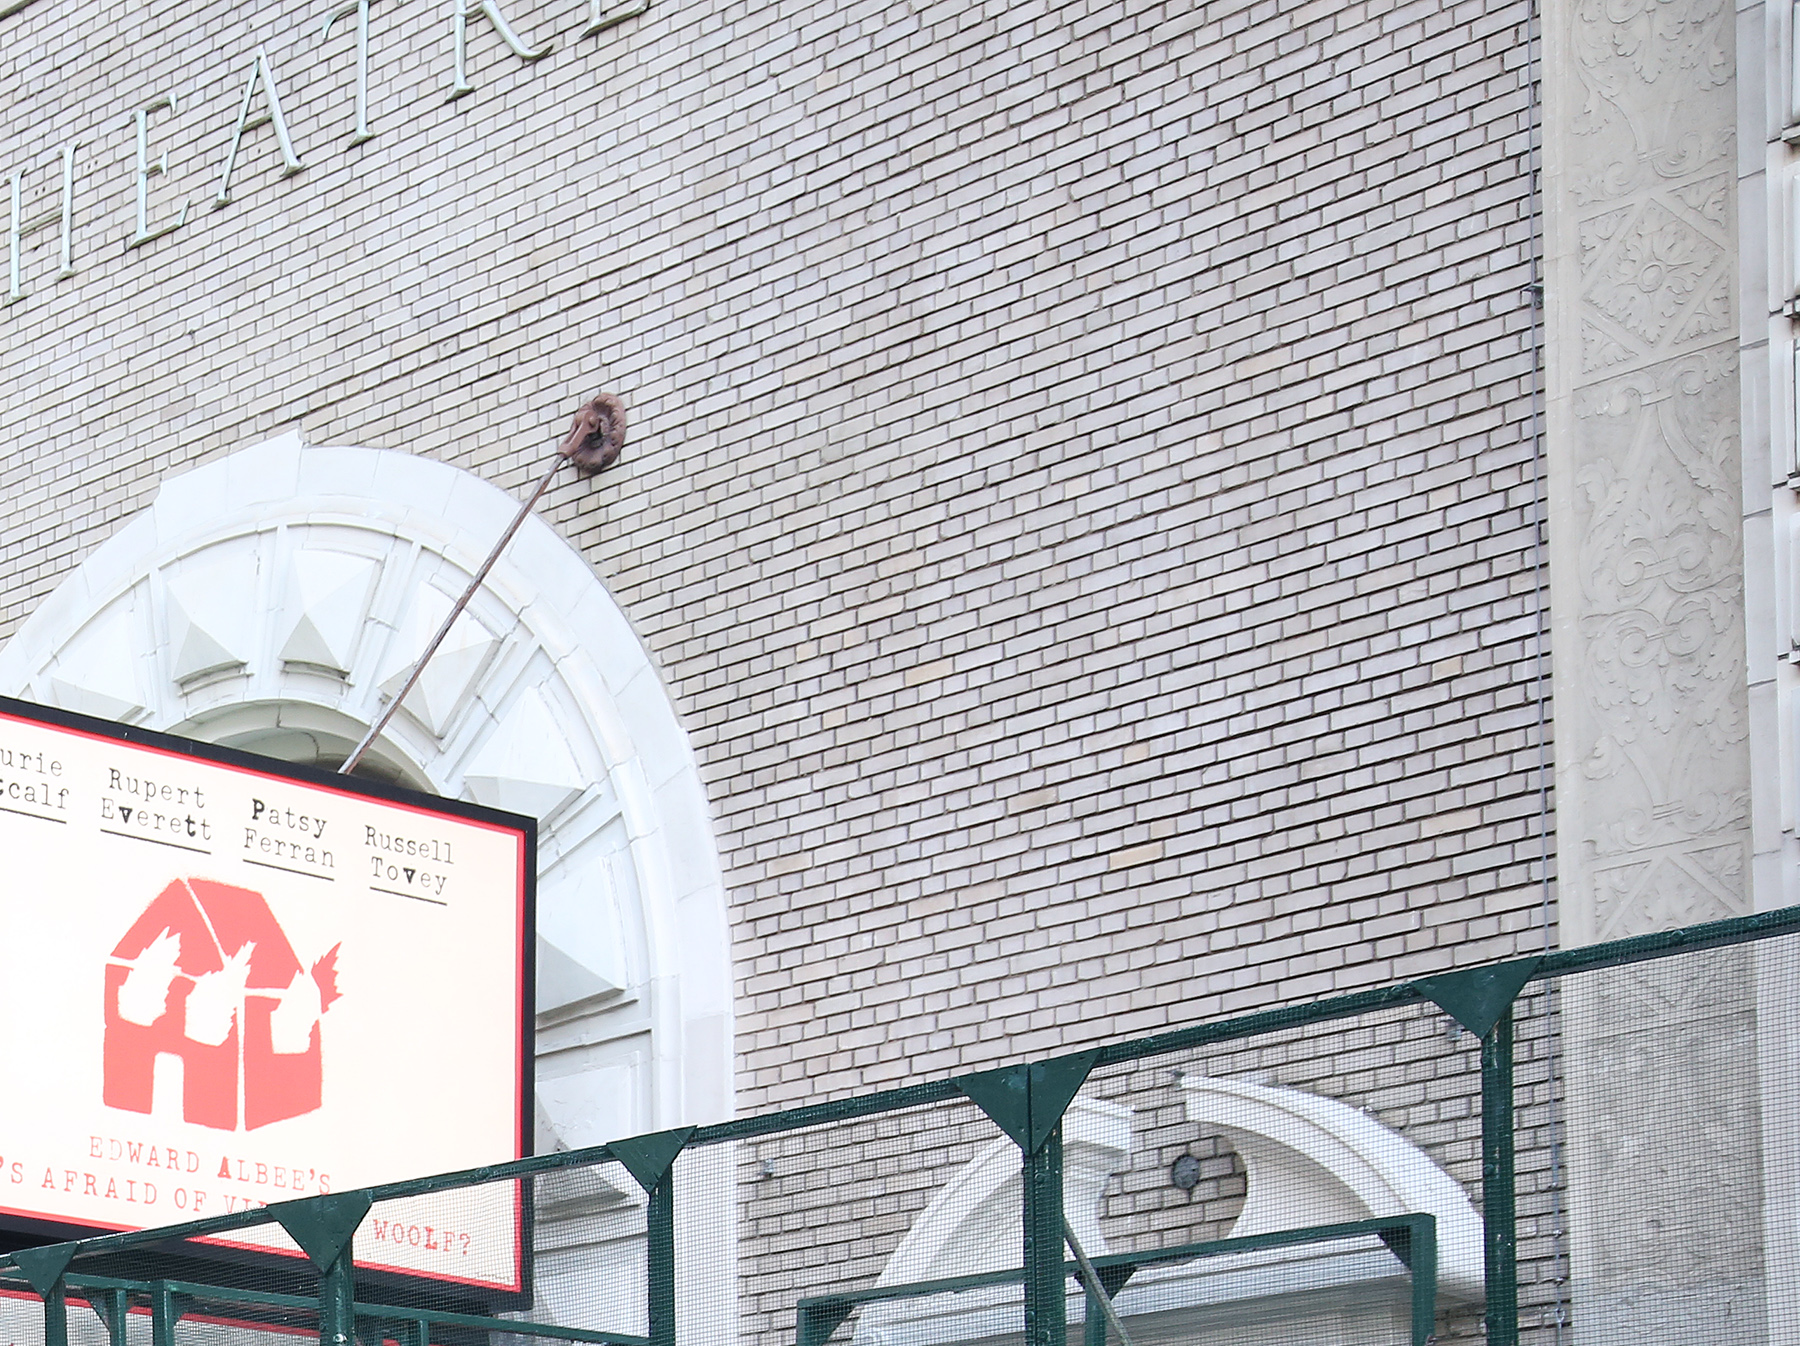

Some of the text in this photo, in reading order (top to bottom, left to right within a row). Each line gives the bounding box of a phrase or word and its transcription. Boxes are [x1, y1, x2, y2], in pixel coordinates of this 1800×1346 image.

[109, 768, 205, 809] Rupert
[102, 797, 212, 840] Everett
[252, 798, 327, 839] Patsy
[244, 828, 335, 868] Ferran
[365, 825, 454, 864] Russell
[371, 856, 447, 895] Tovey
[89, 1136, 331, 1195] EDWARD ALBEE'S
[41, 1167, 157, 1204] AFRAID
[174, 1187, 206, 1211] OF
[372, 1219, 471, 1255] WOOLF?
